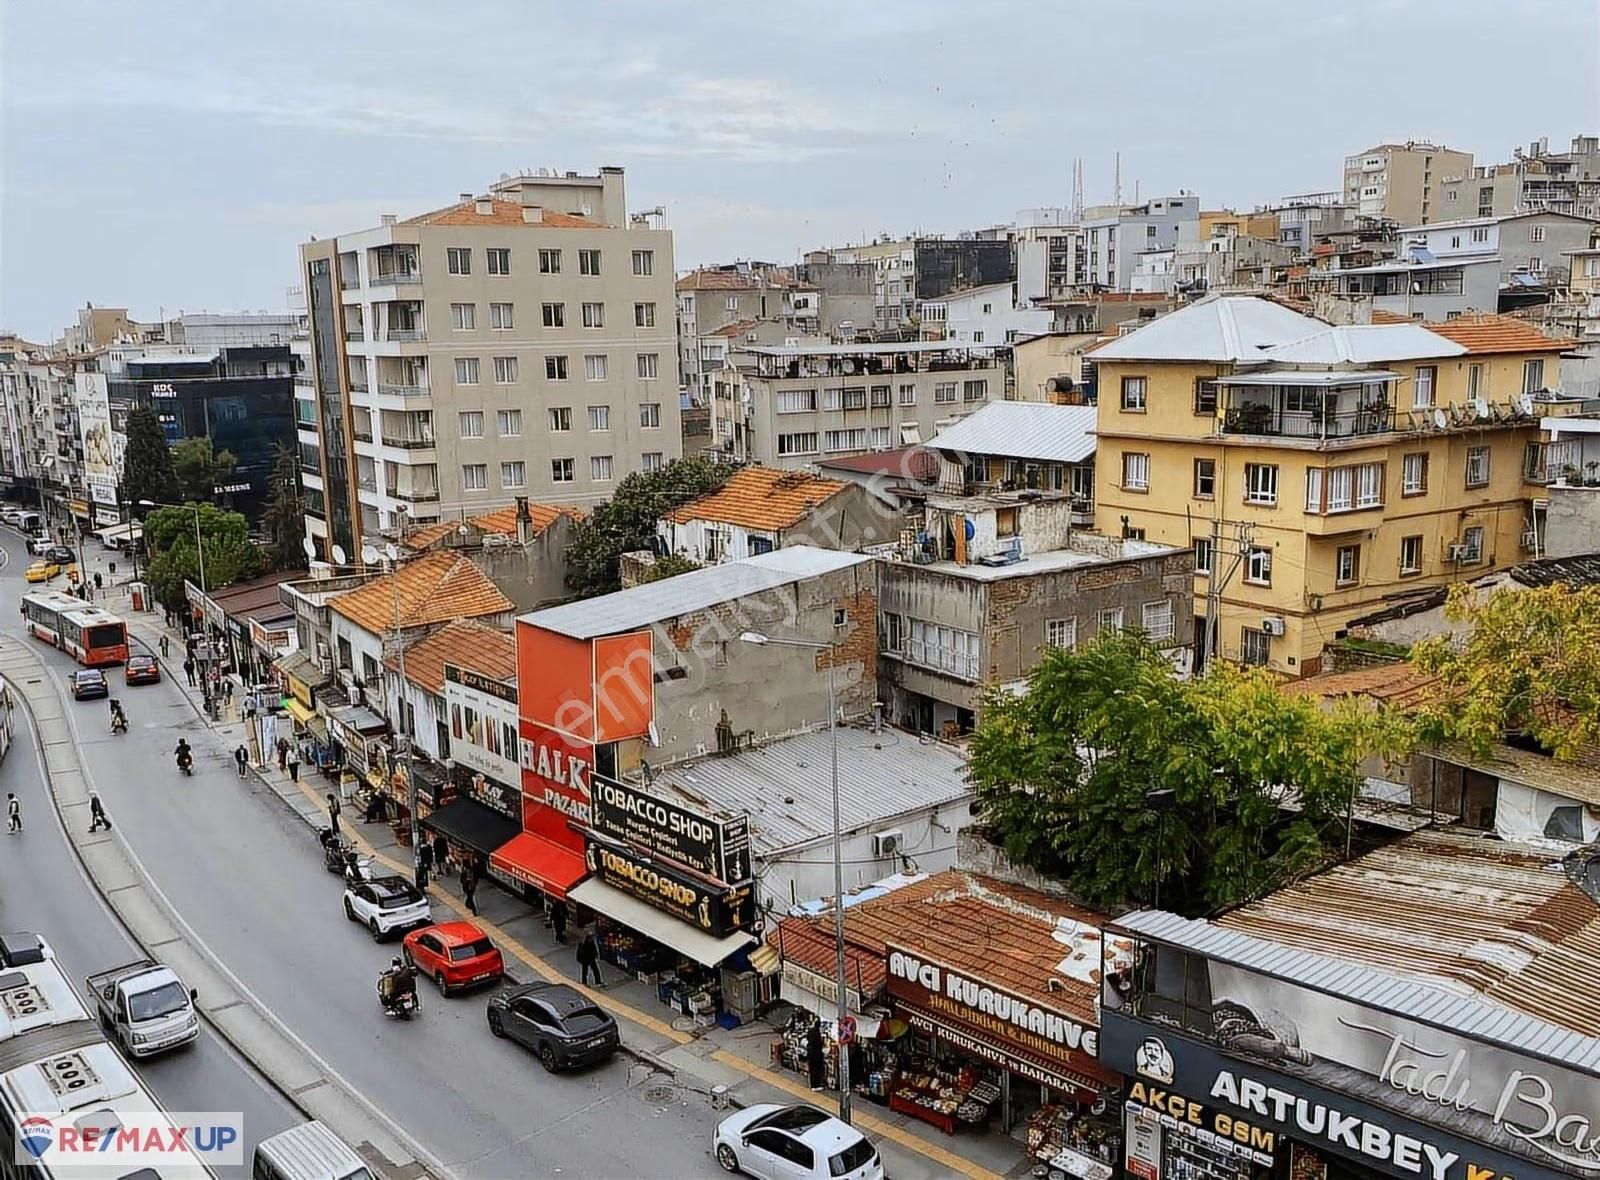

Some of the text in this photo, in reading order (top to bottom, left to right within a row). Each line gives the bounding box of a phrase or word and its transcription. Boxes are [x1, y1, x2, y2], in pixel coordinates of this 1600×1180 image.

[519, 737, 591, 797] HALK
[594, 781, 714, 845] TOBACCO SHOP
[599, 848, 659, 889] TOBACCO
[659, 877, 697, 907] SHOP
[889, 951, 941, 992] AVCI
[945, 972, 1099, 1058] KURUKAHVE
[909, 1015, 935, 1034] AVCI
[937, 1025, 1006, 1066] KURUKAHVE
[1019, 1064, 1078, 1096] BAHARAT
[1129, 1081, 1274, 1154] AKÇE GSM
[1208, 1069, 1461, 1180] ARTUKBEY
